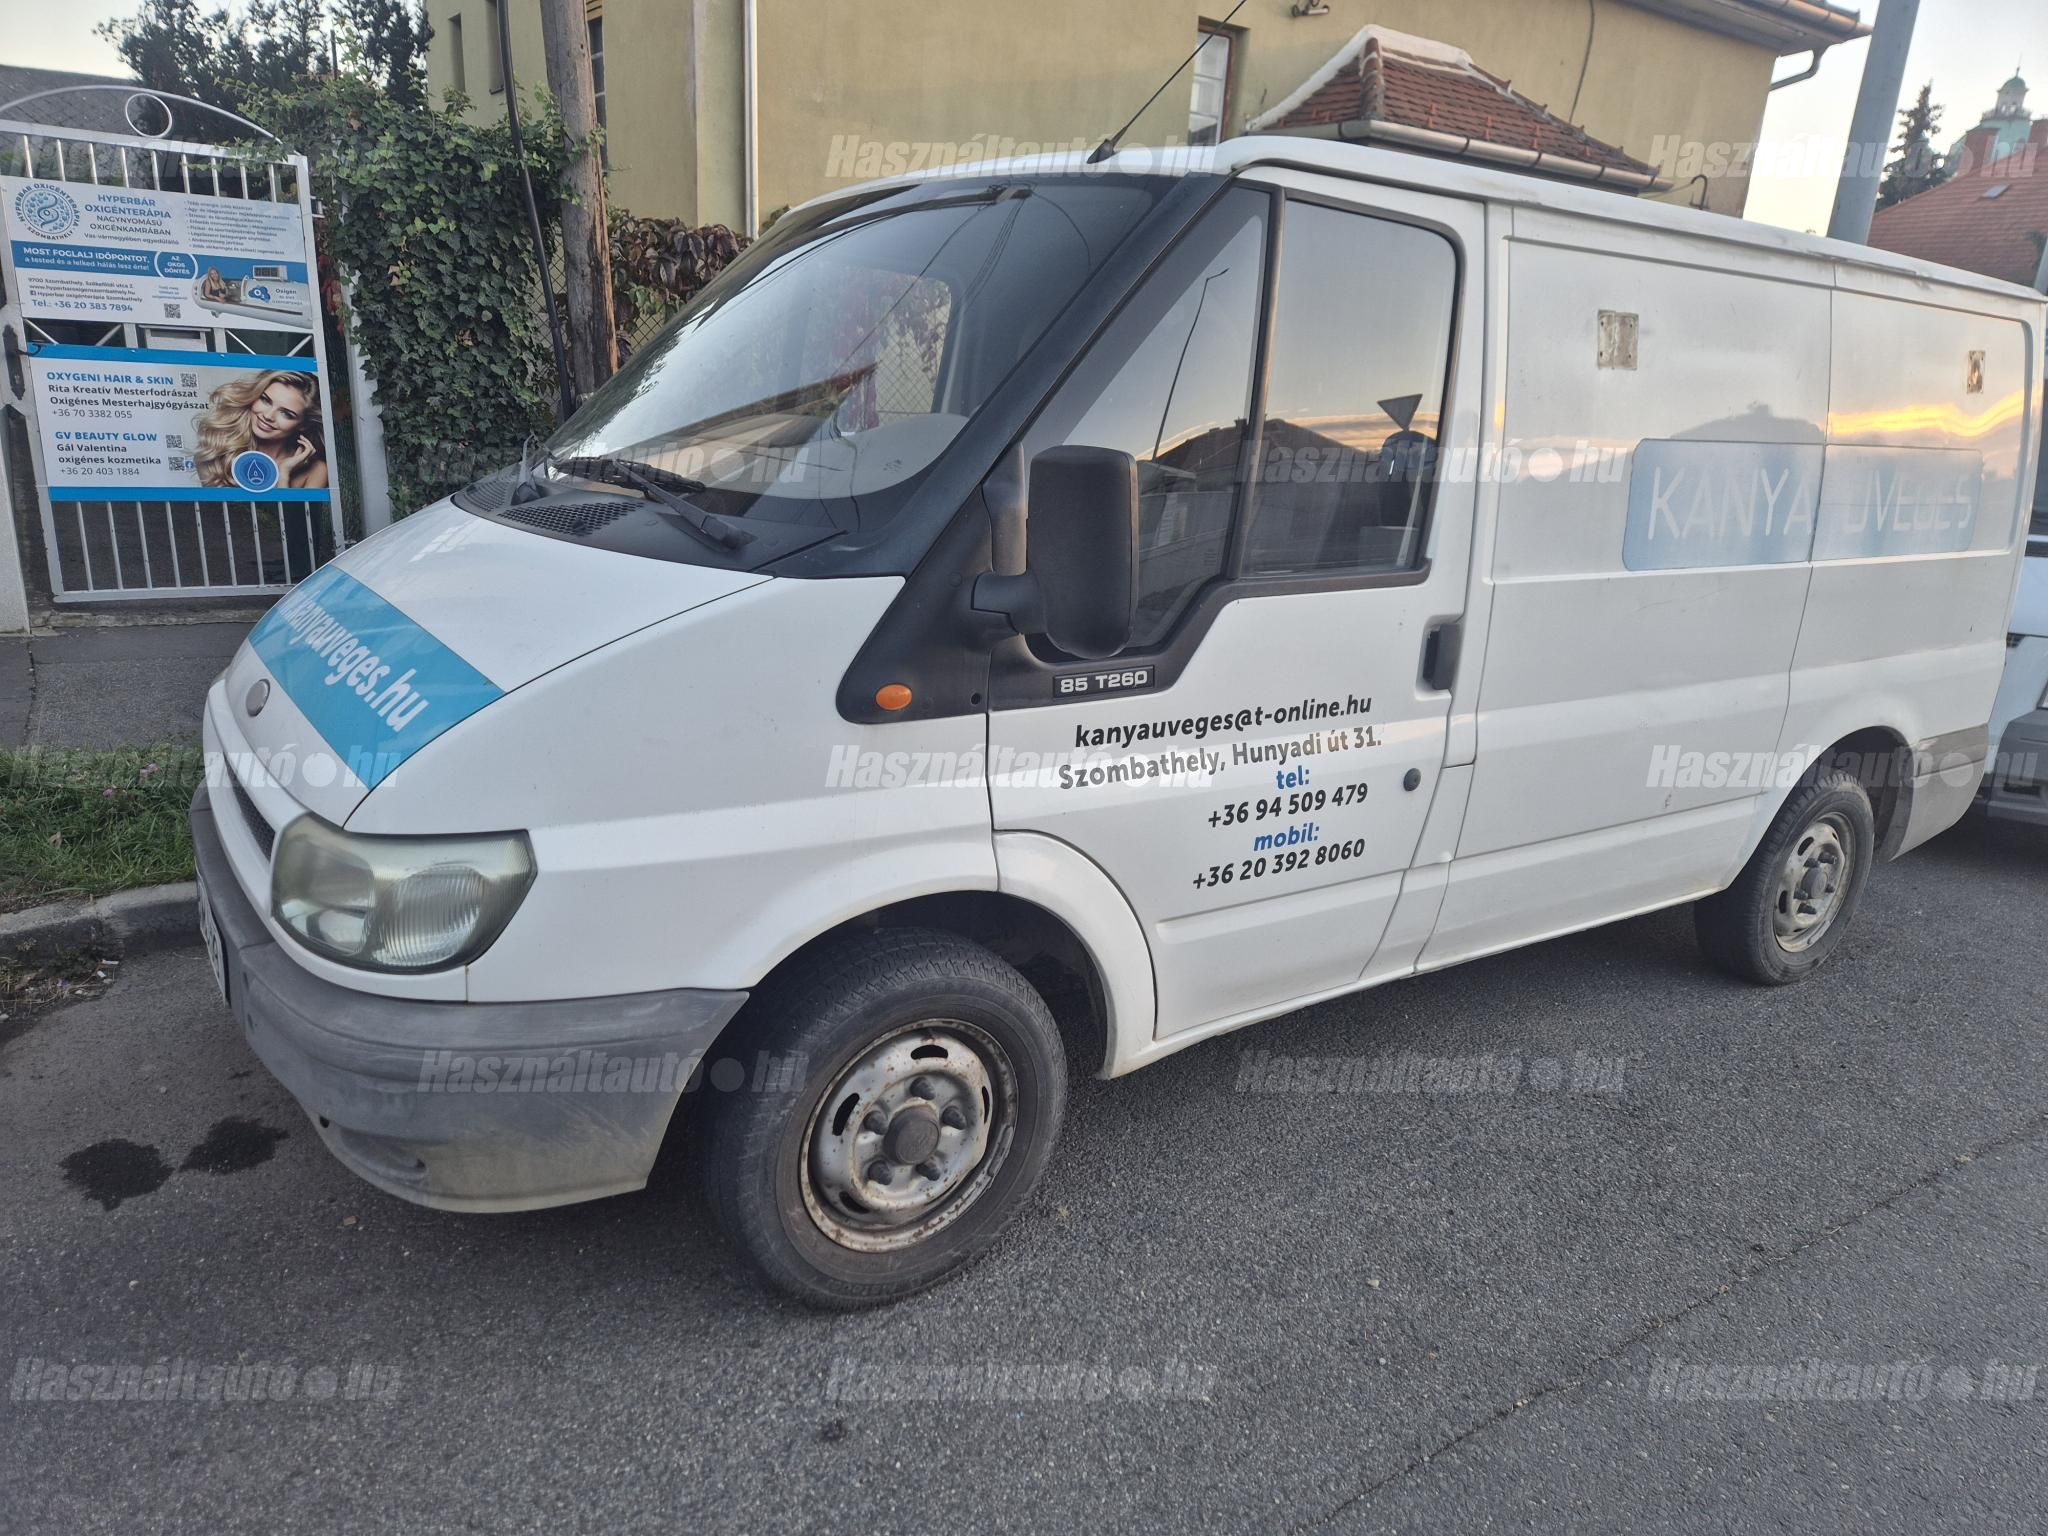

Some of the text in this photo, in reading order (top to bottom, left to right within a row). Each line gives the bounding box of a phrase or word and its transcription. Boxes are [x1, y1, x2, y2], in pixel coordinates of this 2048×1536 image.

[97, 194, 156, 207] HYPERBÁR
[84, 204, 171, 219] OXIGÉNTERÁPIA
[96, 215, 163, 227] NAGYNYOMÁSÚ
[89, 223, 171, 235] OXIGÉNKAMRÁBAN
[23, 247, 50, 256] MOST
[53, 249, 93, 258] FOGLALJ
[54, 301, 71, 309] +36
[74, 301, 87, 310] 20
[89, 302, 107, 311] 383
[109, 303, 133, 312] 7894
[47, 372, 174, 385] OXYGENI HAIR & SKIN
[48, 384, 198, 398] Rita Kreatív Mesterfodrászat
[50, 396, 209, 410] Oxigénes Mesterhajgyógyászat
[52, 409, 133, 419] +36 70 3382 055
[55, 431, 158, 442] GV BEAUTY GLOW
[56, 443, 127, 453] Gál Valentina
[58, 455, 161, 466] oxigénes kozmetika
[61, 467, 140, 476] +36 20 403 1884
[1647, 466, 1813, 541] KANYA
[1060, 671, 1148, 693] 85 T260
[1074, 694, 1373, 749] kanyauveges@t-online.hu
[1058, 725, 1383, 790] Szombathely, Hunyadi út 31.
[1275, 765, 1311, 790] tel:
[1208, 782, 1368, 828] +36 94 509 479
[1253, 822, 1320, 852] mobil:
[1193, 838, 1366, 890] +36 20 392 8060
